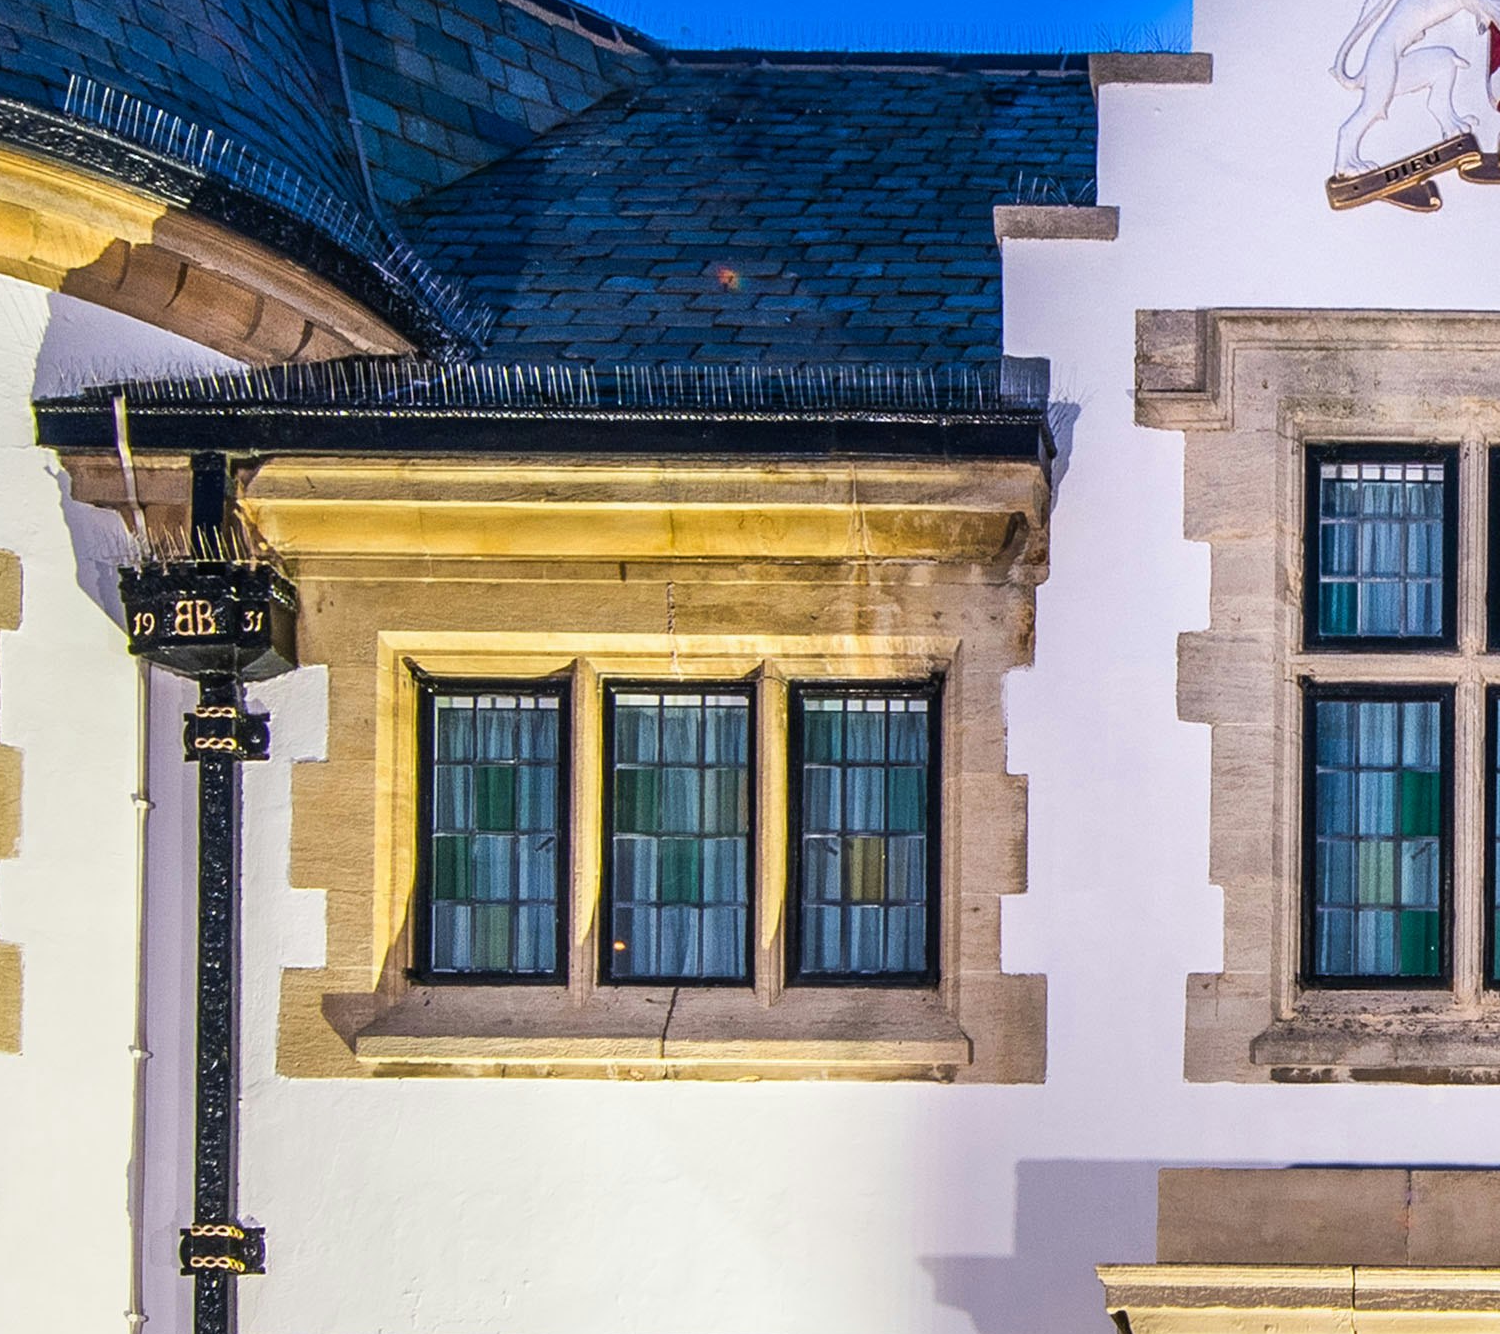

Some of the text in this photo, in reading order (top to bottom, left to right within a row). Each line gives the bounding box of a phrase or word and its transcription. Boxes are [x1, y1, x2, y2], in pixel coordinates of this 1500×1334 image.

[1384, 150, 1441, 183] DIEU
[133, 612, 155, 636] 19
[243, 610, 264, 632] 31
